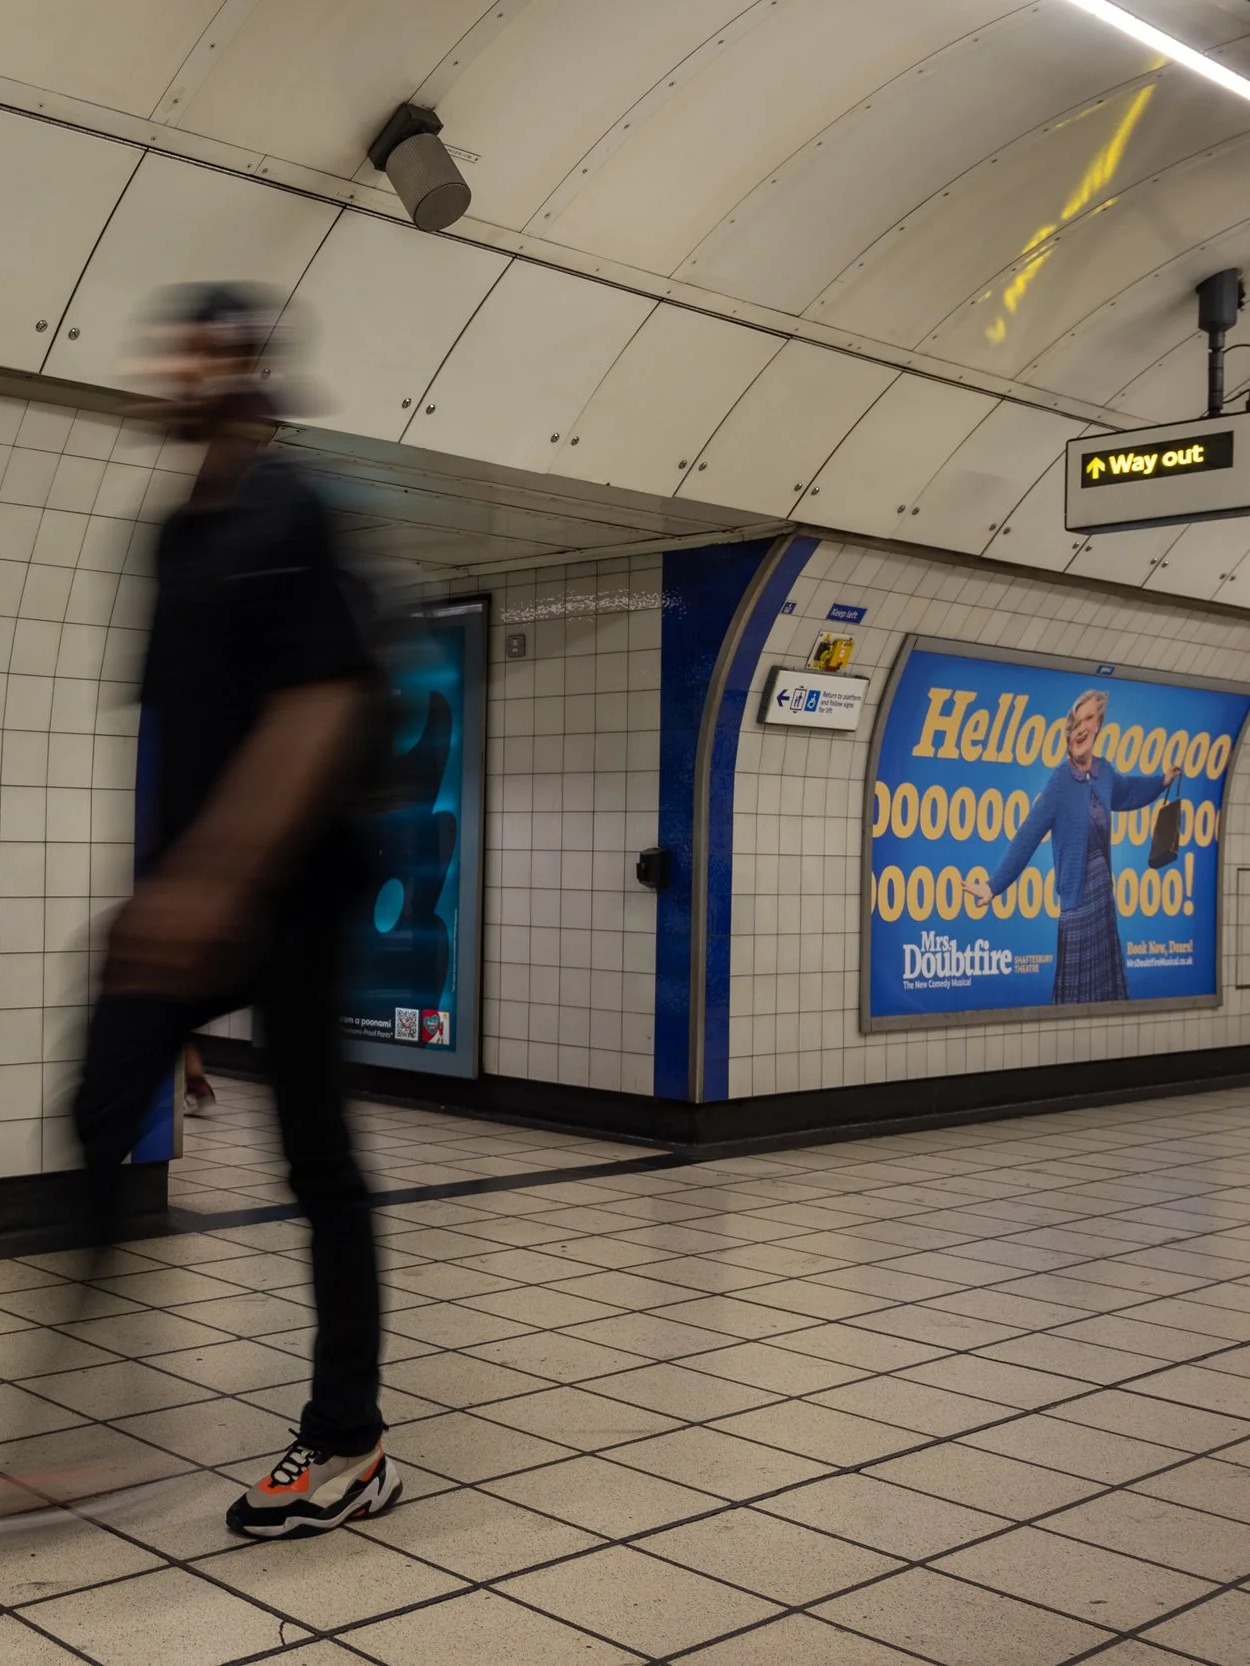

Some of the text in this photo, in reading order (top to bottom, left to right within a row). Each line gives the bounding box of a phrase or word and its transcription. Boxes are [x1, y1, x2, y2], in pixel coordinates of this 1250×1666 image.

[1109, 444, 1204, 475] Way out
[830, 608, 859, 620] Keep left
[822, 690, 837, 699] Return
[843, 702, 855, 710] signs
[1127, 940, 1147, 955] Book
[902, 938, 1013, 979] Doubtfire
[1013, 953, 1054, 965] SHAFTESBURY
[1014, 963, 1039, 973] THEATRE
[903, 977, 971, 989] The New Comedy Musical
[361, 1018, 392, 1029] poonami
